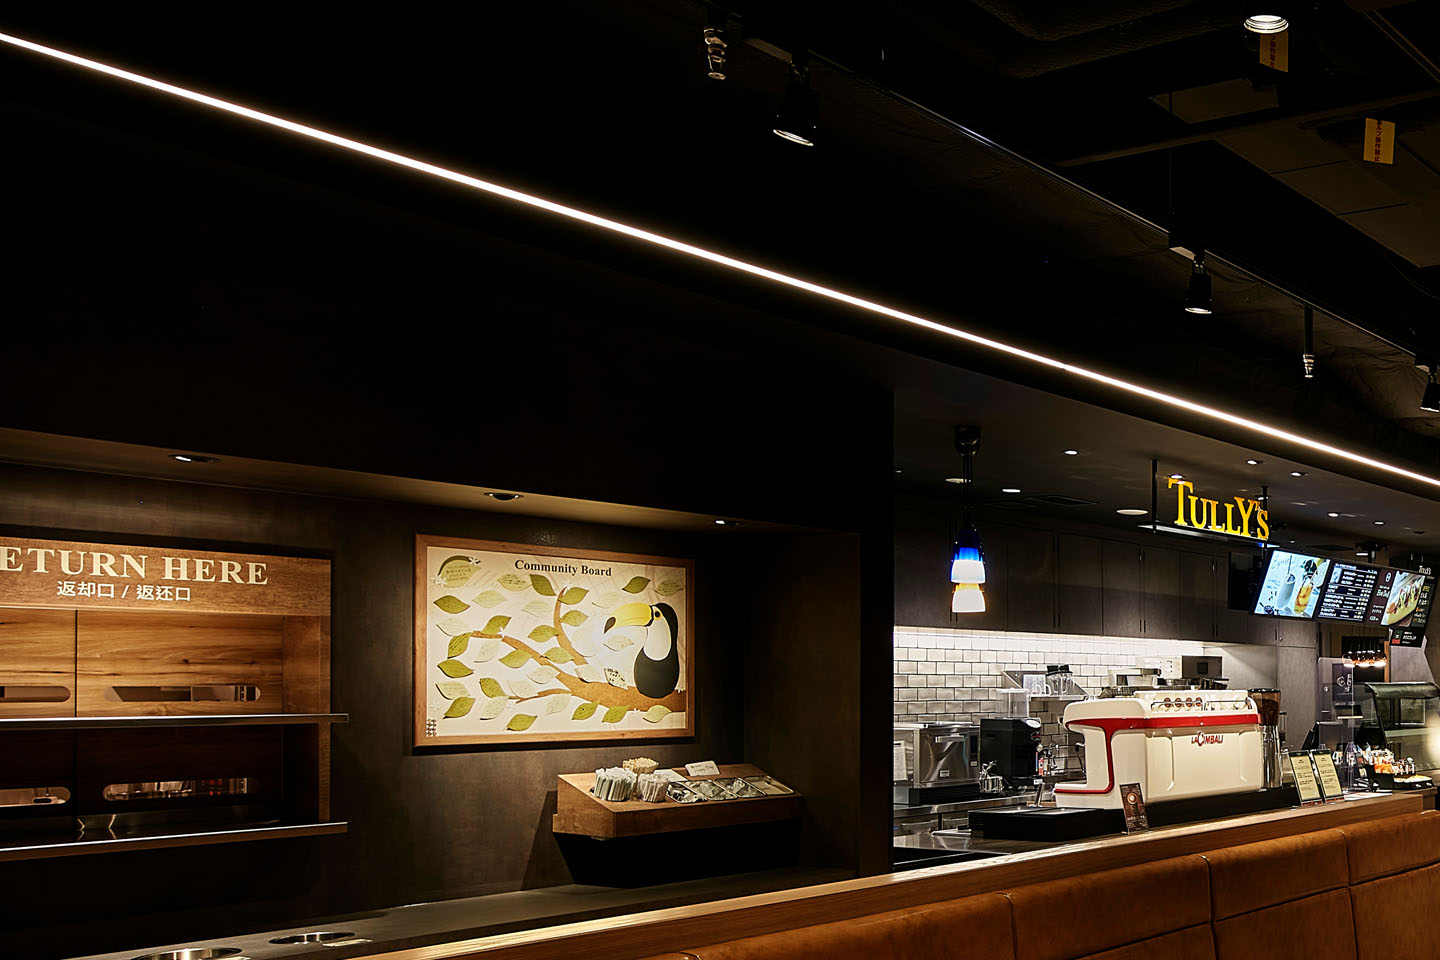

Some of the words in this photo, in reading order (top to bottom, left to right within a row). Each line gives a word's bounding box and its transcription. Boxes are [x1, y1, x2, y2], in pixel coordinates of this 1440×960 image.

[1167, 477, 1270, 541] TULLY'S
[161, 556, 269, 585] HERE
[514, 559, 578, 576] Community
[581, 565, 612, 576] Board
[57, 581, 115, 598] 返却口
[136, 584, 191, 601] 返还口
